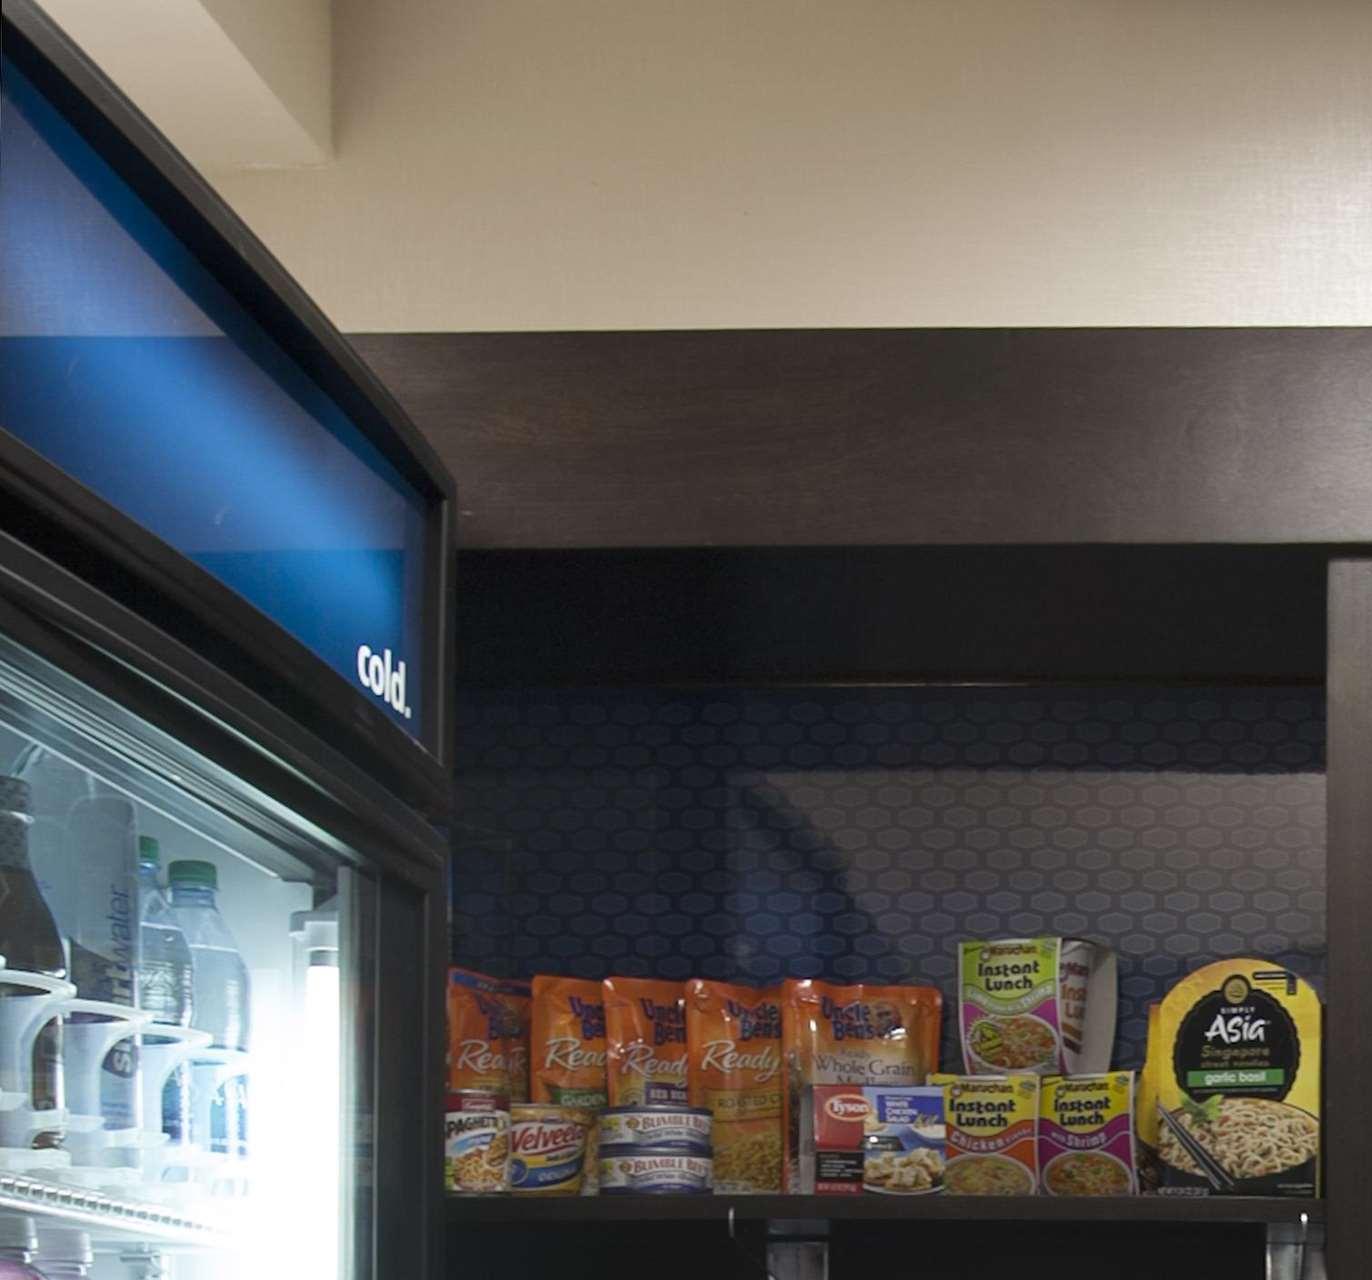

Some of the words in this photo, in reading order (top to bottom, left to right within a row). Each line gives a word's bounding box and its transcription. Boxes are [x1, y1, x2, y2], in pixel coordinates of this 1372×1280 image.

[356, 643, 412, 718] cold.
[977, 961, 1041, 978] Instant
[984, 976, 1034, 992] Lunch
[1219, 1005, 1256, 1015] SIMPLY
[1203, 1014, 1266, 1045] Asia
[700, 1039, 782, 1083] Ready
[814, 1052, 867, 1074] Whole
[1203, 1071, 1237, 1086] garlic
[831, 1098, 869, 1115] Tyson
[949, 1099, 1016, 1117] Instant
[1053, 1097, 1111, 1113] Instant
[956, 1114, 1009, 1129] Lunch
[1059, 1113, 1105, 1127] Lunch
[950, 1130, 1006, 1151] Chicken
